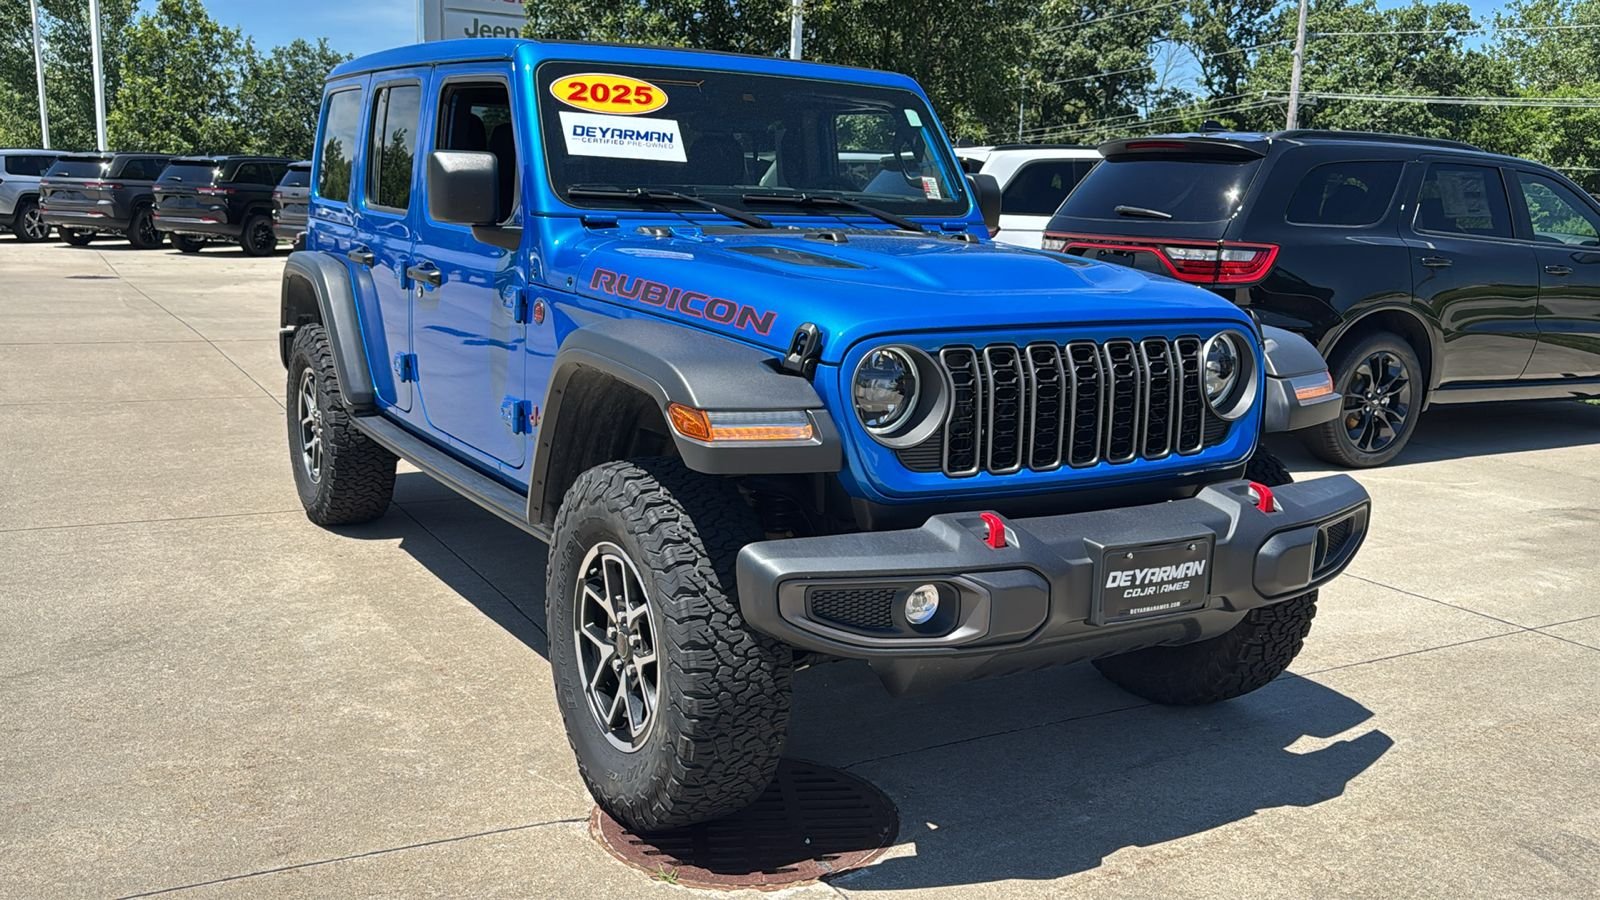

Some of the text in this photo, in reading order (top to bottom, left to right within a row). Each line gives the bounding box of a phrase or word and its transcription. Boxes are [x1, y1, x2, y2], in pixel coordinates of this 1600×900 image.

[567, 81, 653, 105] 2025
[572, 125, 674, 143] DEYARMAN
[582, 136, 674, 150] CERTIFIED PRE-OWNED
[590, 268, 777, 336] RUBICON
[1105, 559, 1206, 589] DEYARMAN
[1160, 580, 1190, 594] AMES
